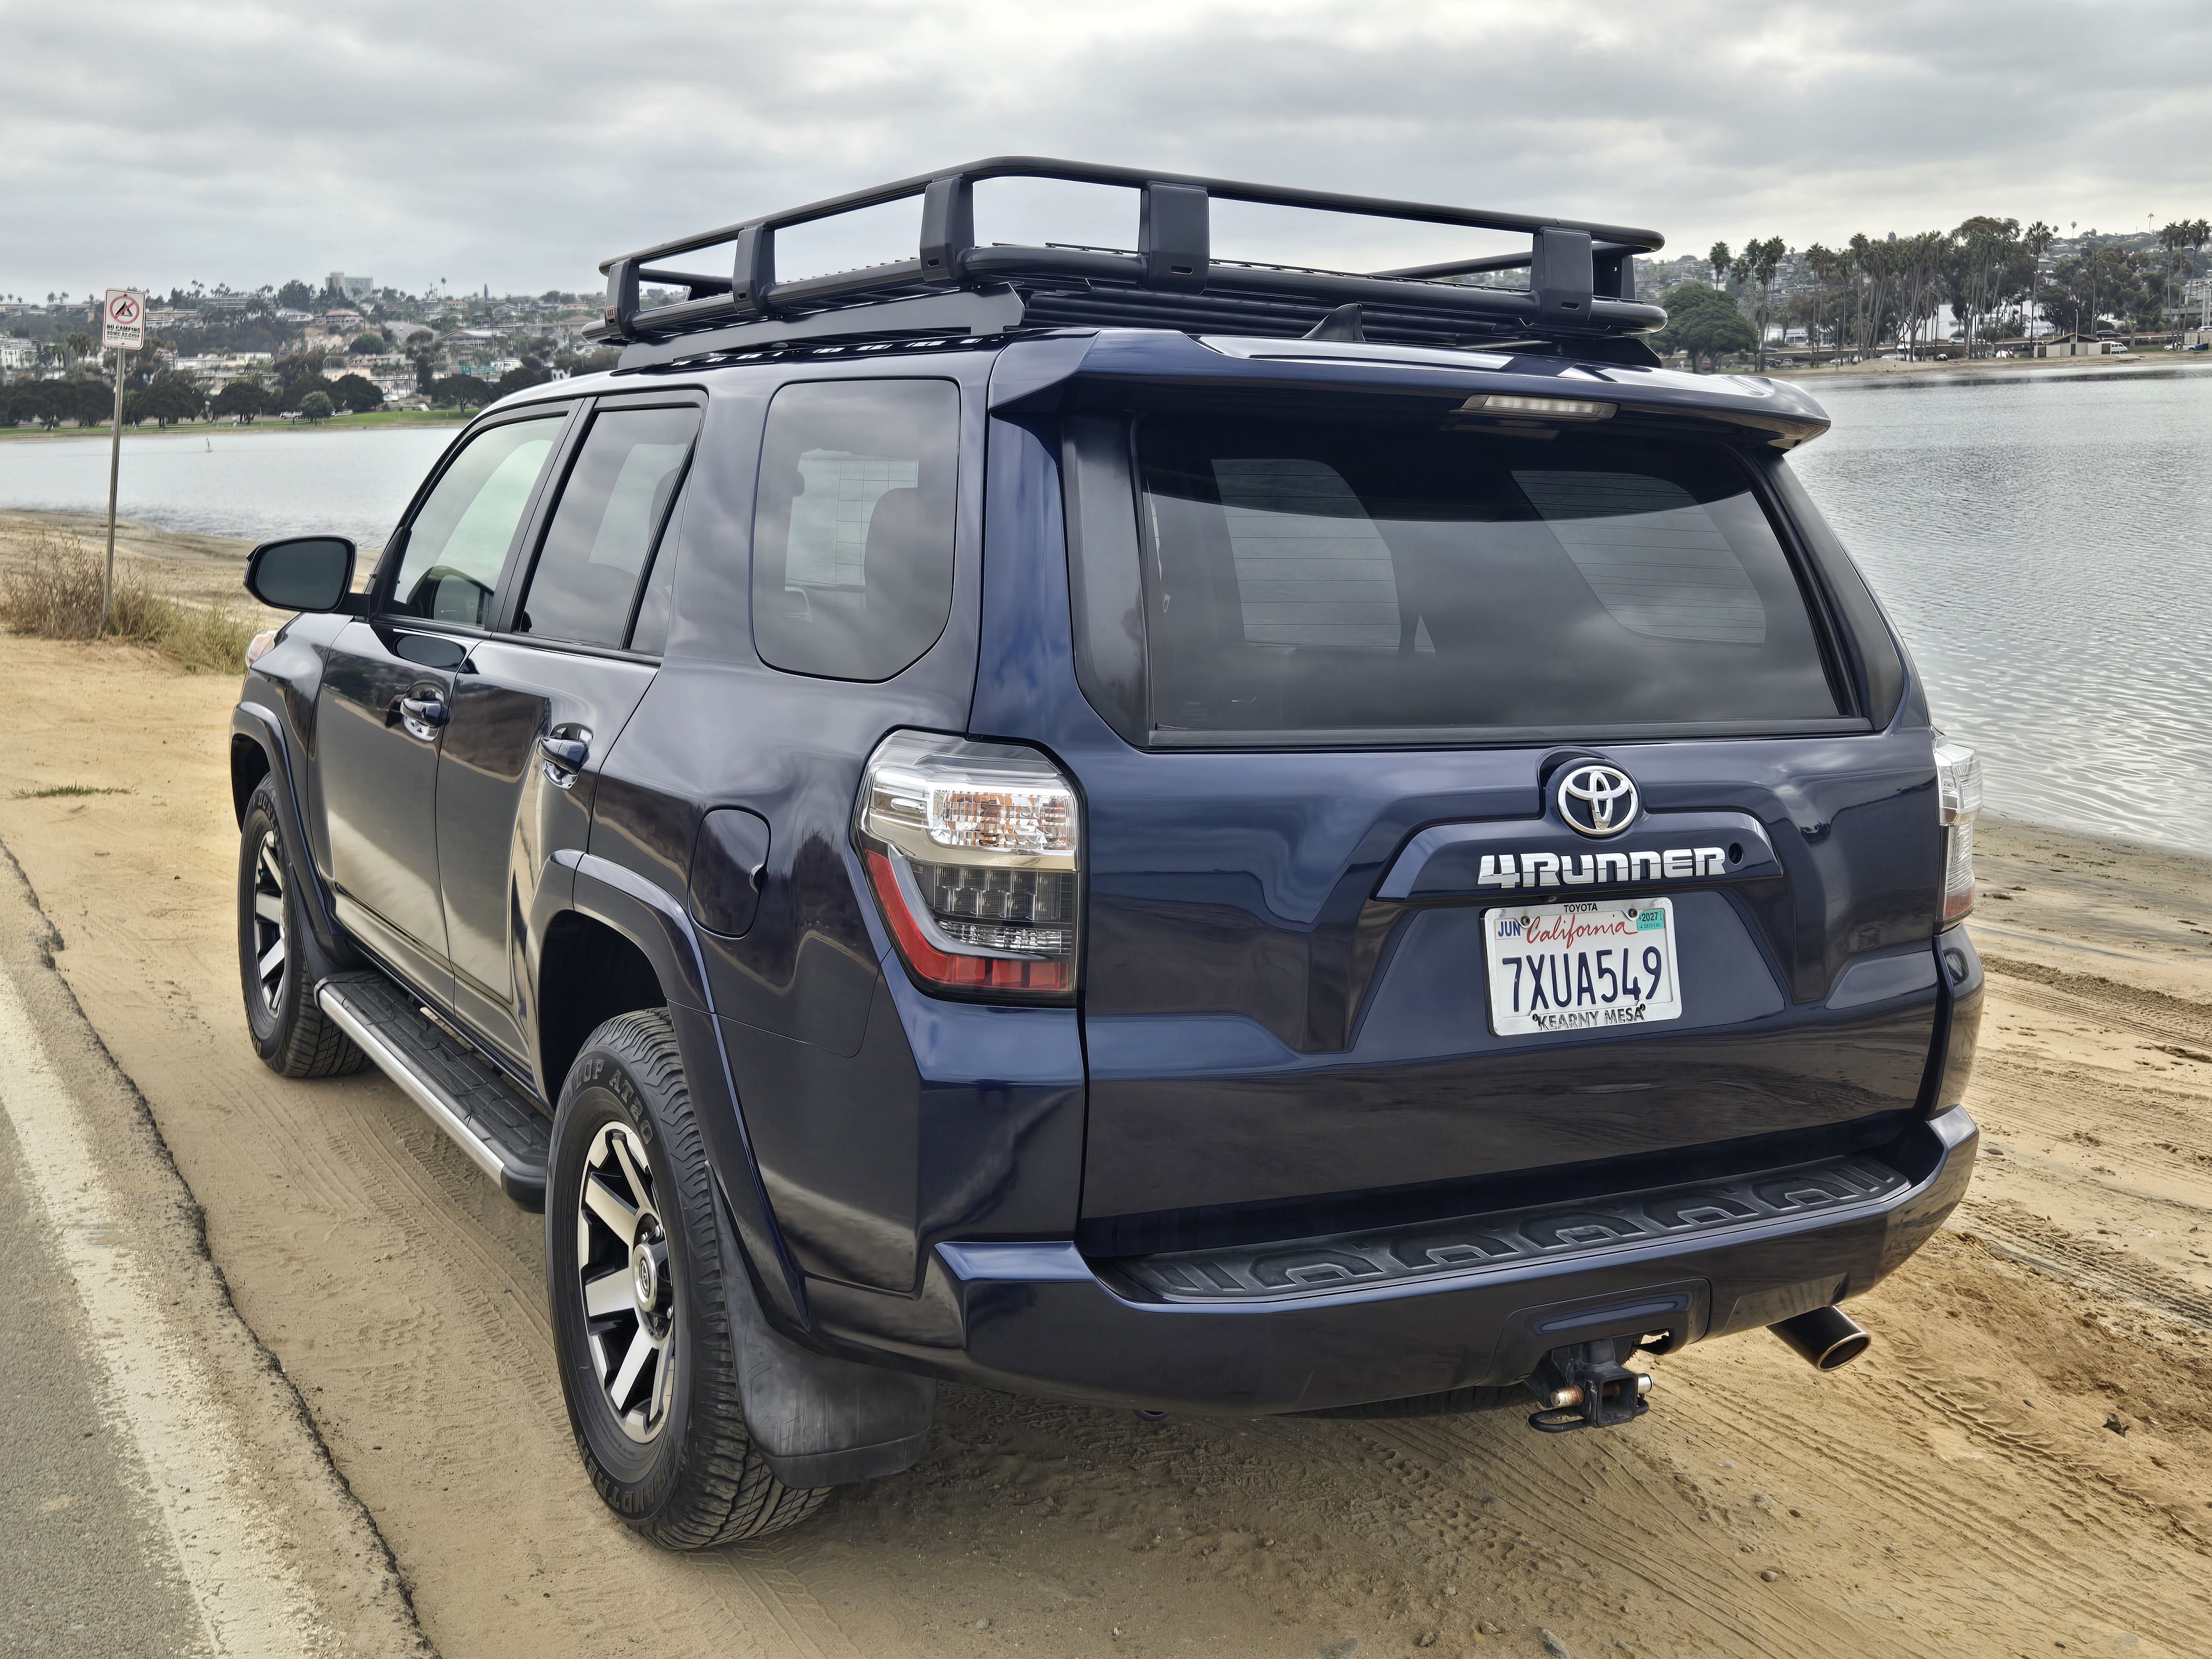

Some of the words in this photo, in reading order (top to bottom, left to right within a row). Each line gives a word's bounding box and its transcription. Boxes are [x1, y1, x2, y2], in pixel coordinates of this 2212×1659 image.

[1477, 847, 1726, 888] 4RUNNER
[1563, 903, 1598, 912] TOYOTA
[1642, 912, 1658, 921] 2027
[1498, 921, 1521, 937] JUN
[1526, 914, 1638, 949] California
[1502, 946, 1662, 1012] 7XUA549
[1537, 1011, 1599, 1031] KEARNY
[1605, 1006, 1645, 1025] MESA
[609, 1070, 653, 1145] AT20
